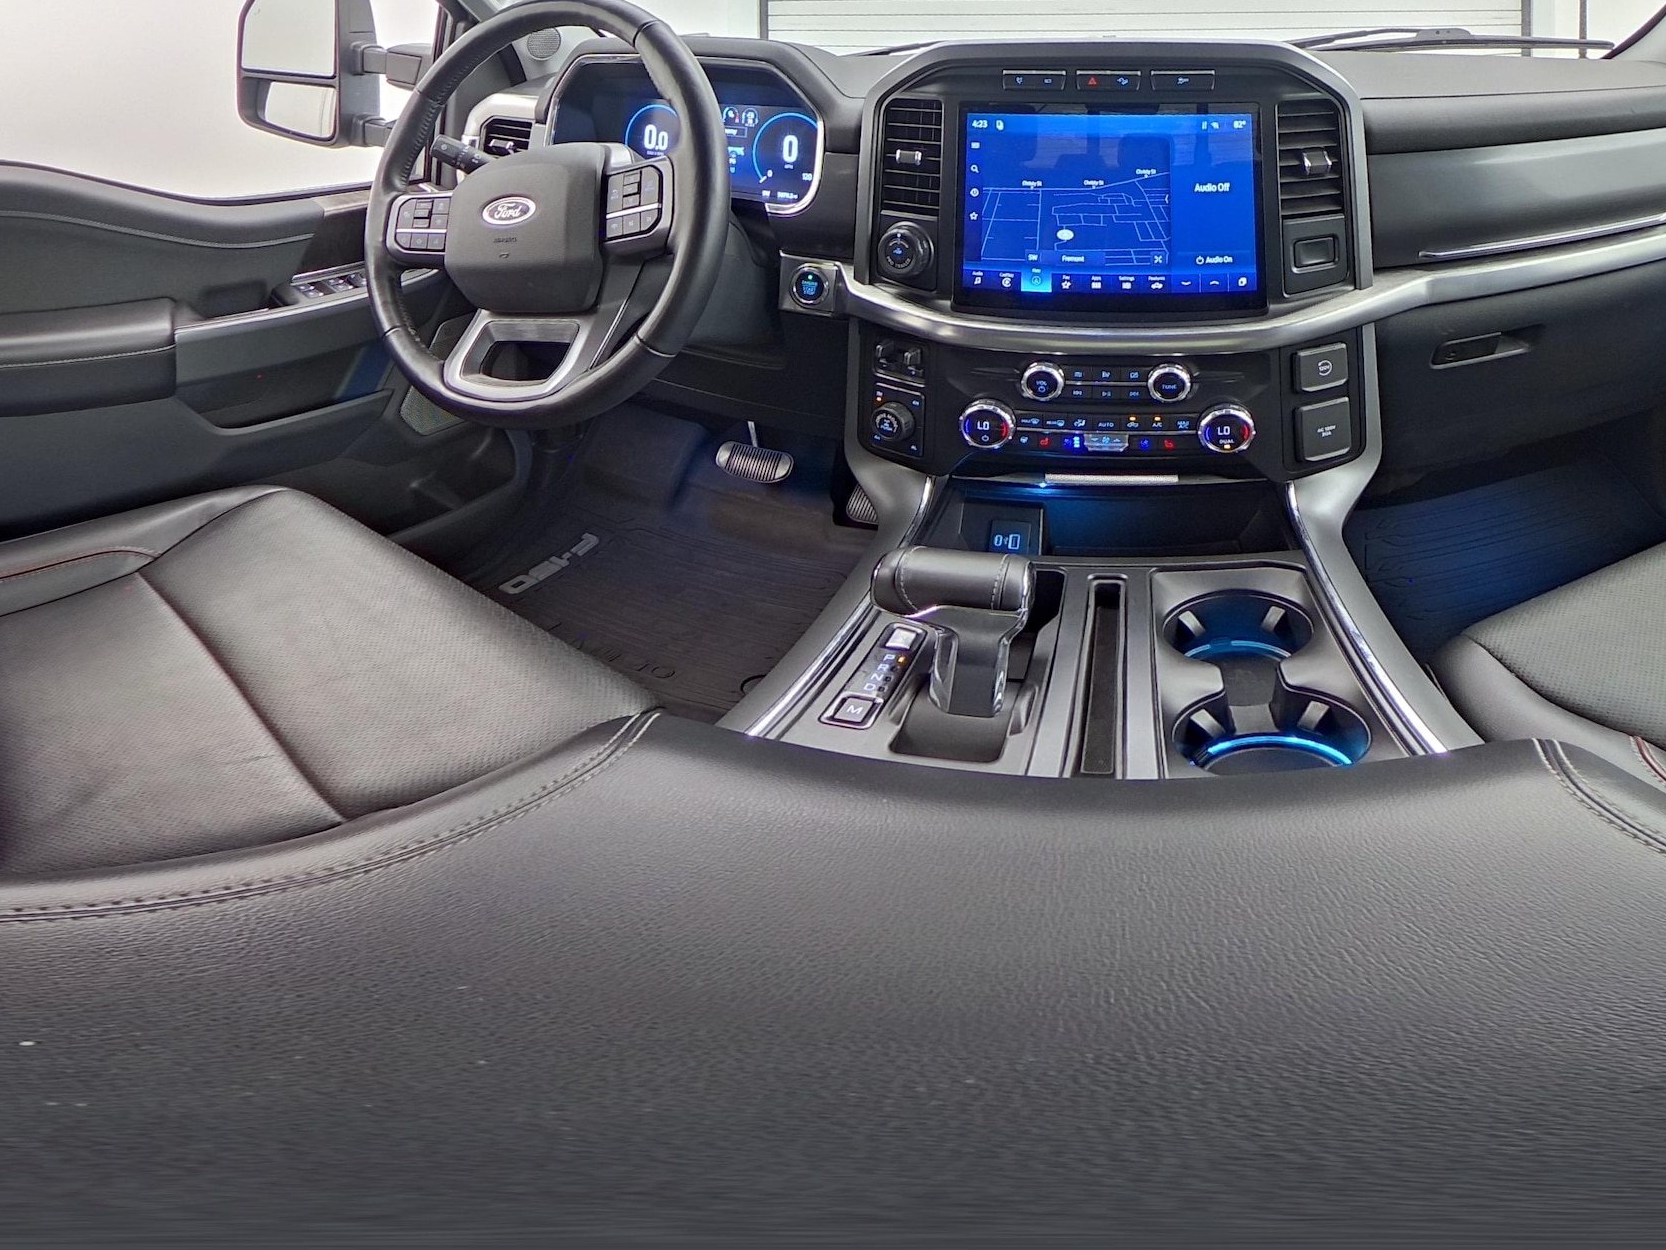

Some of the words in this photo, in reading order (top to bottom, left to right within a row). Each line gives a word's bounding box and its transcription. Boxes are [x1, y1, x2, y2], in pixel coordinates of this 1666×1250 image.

[644, 124, 668, 151] 0.0
[783, 134, 798, 163] 0
[767, 169, 773, 178] 0
[1194, 182, 1217, 192] Audio
[1217, 182, 1230, 192] Off
[494, 202, 523, 219] Ford
[1205, 256, 1223, 264] Audio
[977, 420, 990, 431] LO
[1217, 426, 1231, 436] LO
[877, 663, 889, 671] R
[871, 673, 884, 681] N
[863, 683, 875, 691] D
[846, 705, 864, 715] M
